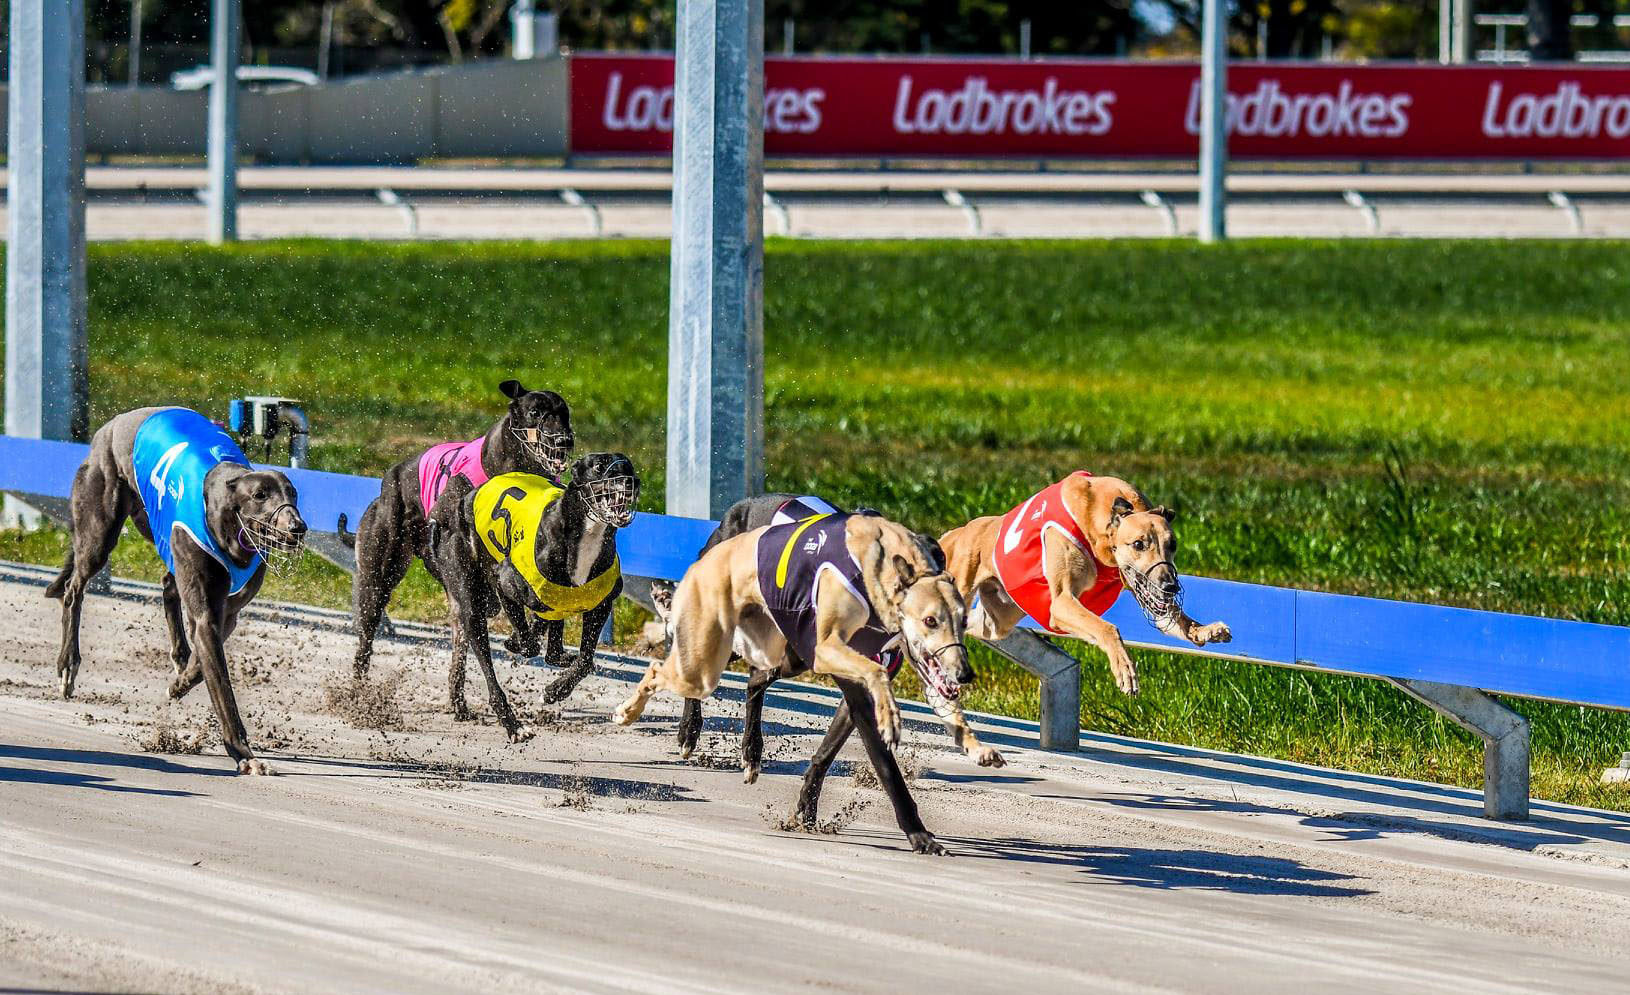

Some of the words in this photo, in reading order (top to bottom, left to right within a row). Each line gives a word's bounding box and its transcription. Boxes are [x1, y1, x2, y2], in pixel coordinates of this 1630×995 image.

[893, 76, 1116, 134] Ladbrokes
[149, 441, 189, 511] 4
[487, 486, 528, 557] 5
